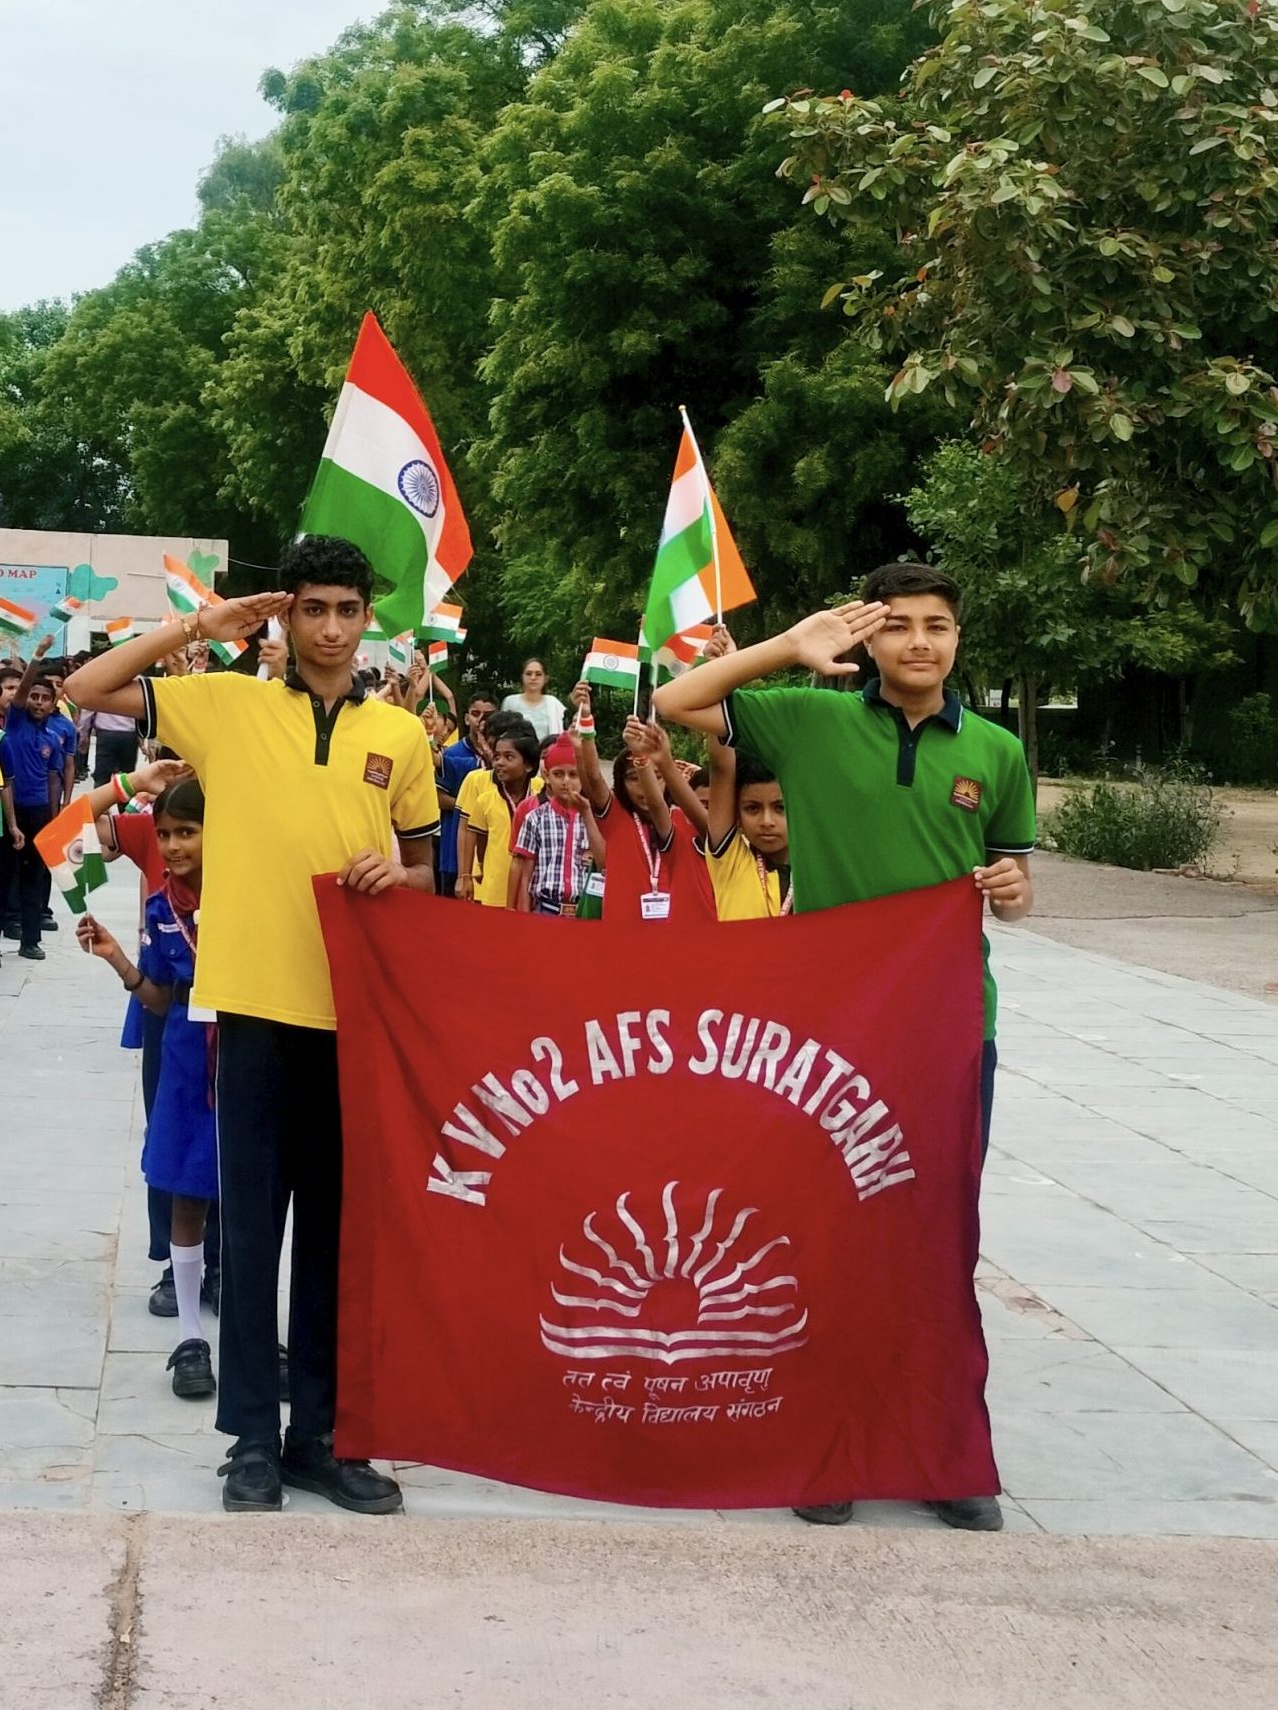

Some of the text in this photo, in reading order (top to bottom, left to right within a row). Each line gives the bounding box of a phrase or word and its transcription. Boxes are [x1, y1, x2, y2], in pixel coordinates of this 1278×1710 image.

[7, 568, 38, 579] MAP
[584, 1008, 674, 1085] AFS
[688, 1008, 916, 1202] SURATGARH
